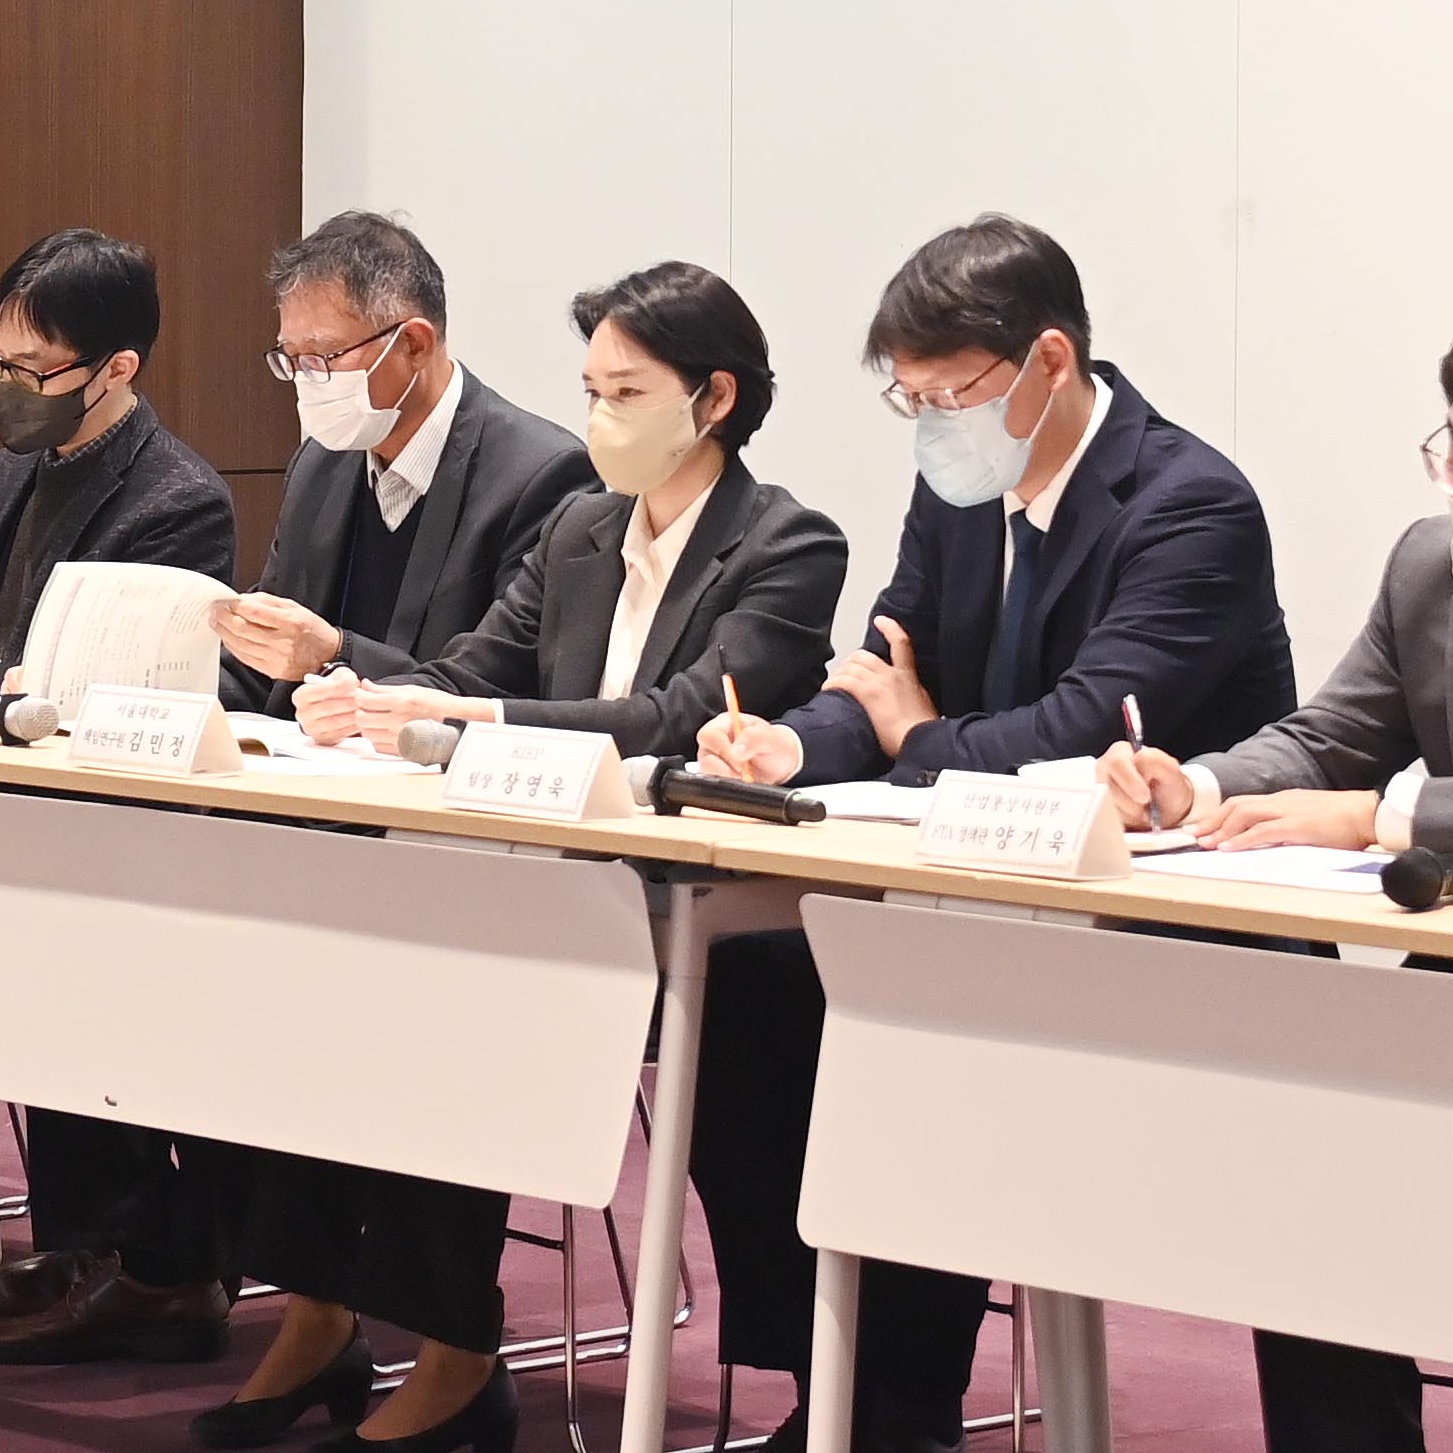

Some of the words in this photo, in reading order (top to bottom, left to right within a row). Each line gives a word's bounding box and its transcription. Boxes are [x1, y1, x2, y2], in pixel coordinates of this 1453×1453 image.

[117, 703, 171, 721] 서울대학교
[467, 771, 494, 789] 팀장
[962, 793, 1062, 816] 산업통상자원부
